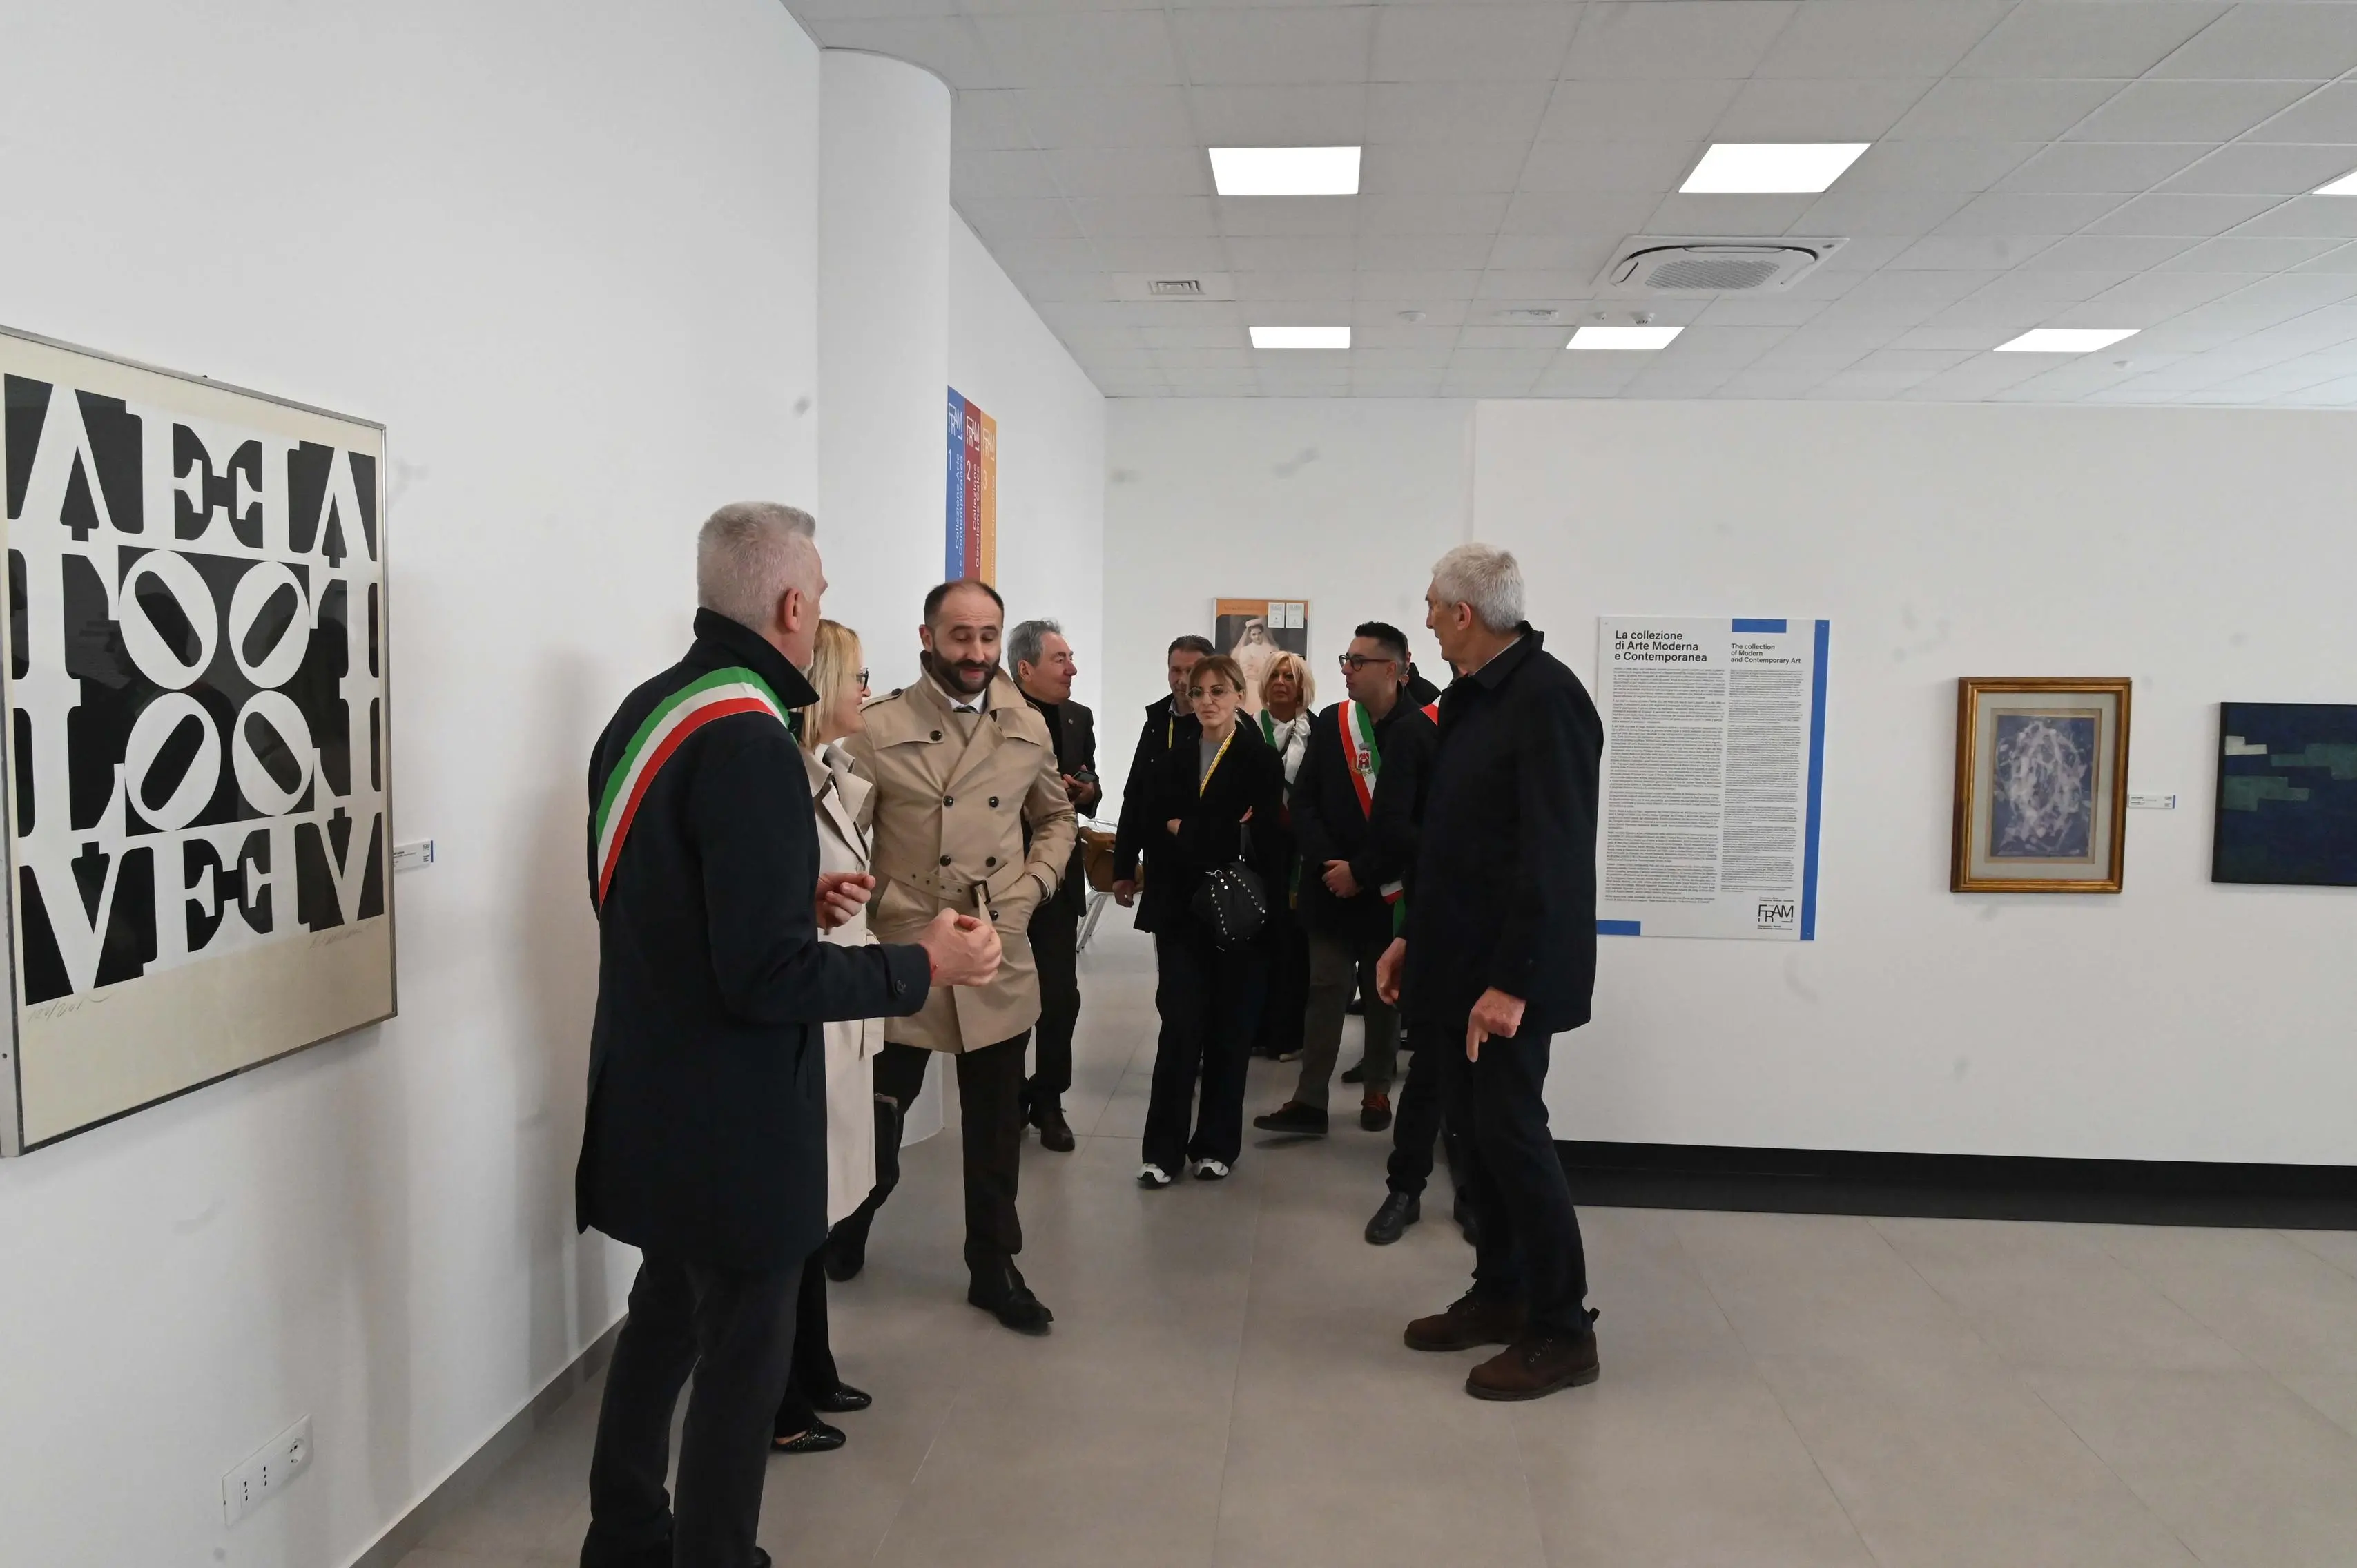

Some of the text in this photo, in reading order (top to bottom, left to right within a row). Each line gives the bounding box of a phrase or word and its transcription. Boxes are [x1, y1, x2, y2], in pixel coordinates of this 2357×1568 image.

[949, 449, 952, 470] 1
[967, 459, 971, 481] 2
[1616, 630, 1683, 640] La collezione
[1615, 641, 1699, 651] di Arte Moderna
[1624, 652, 1707, 663] Contemporanea
[1758, 904, 1794, 922] FRAM
